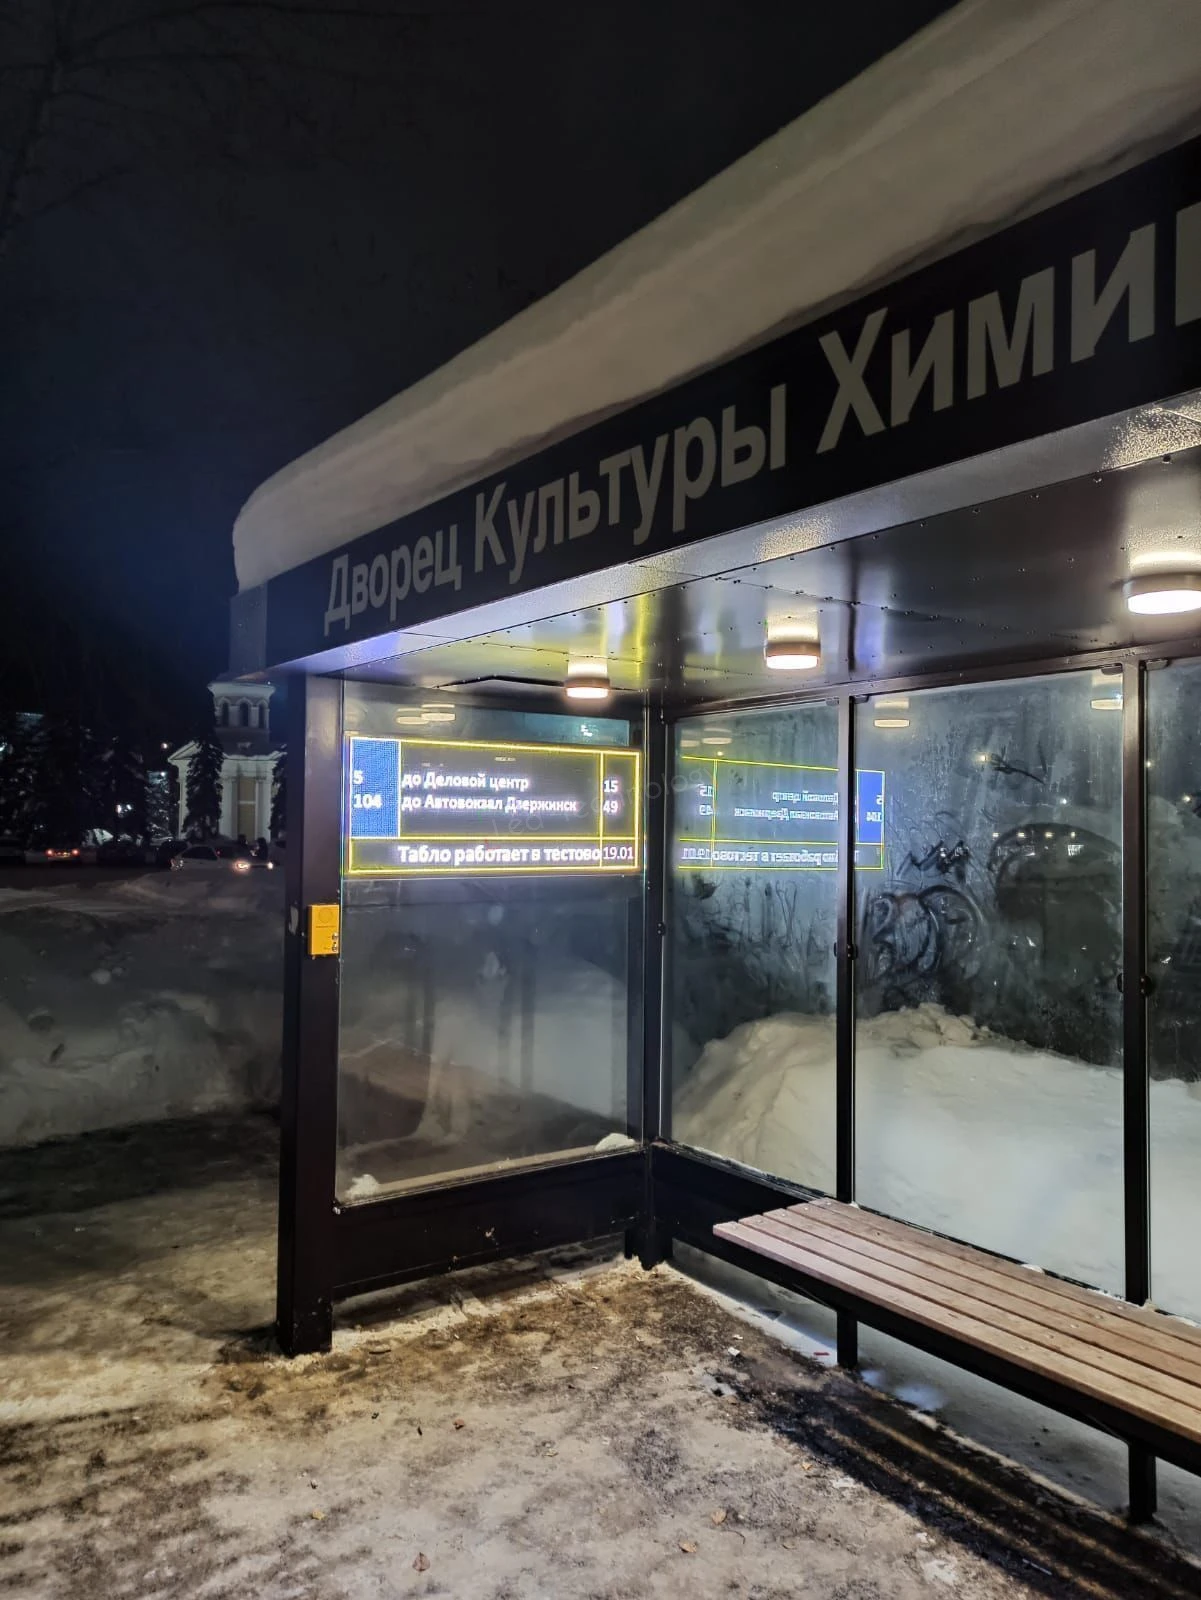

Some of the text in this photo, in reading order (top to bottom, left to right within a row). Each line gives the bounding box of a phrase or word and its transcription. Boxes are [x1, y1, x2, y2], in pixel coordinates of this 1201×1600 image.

[324, 524, 462, 636] Дворец
[474, 383, 787, 585] Культуры
[353, 770, 364, 785] 5
[402, 772, 529, 792] до Деловой центр
[603, 780, 619, 793] 15
[353, 793, 383, 809] 104
[402, 794, 578, 814] до Автовокзал Дзержинск
[603, 800, 619, 814] 49
[397, 845, 600, 866] Табло работает в тестово
[603, 846, 634, 860] 19.01
